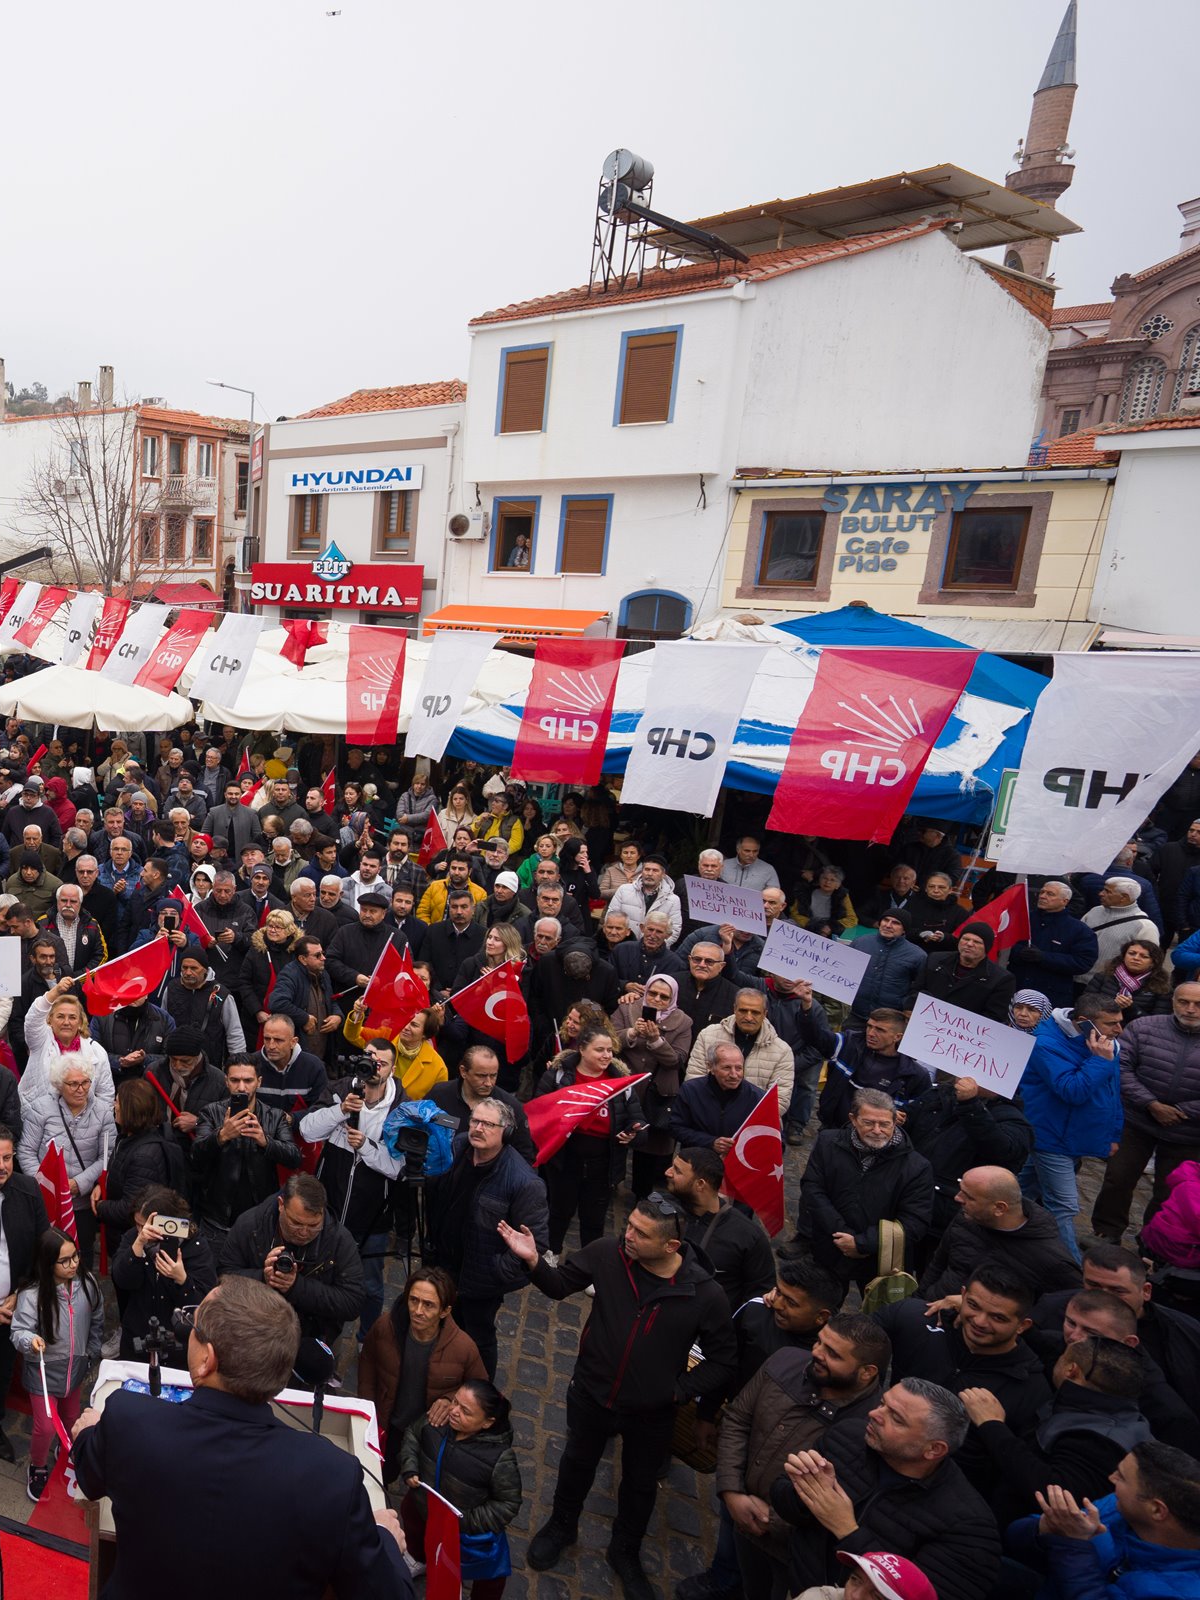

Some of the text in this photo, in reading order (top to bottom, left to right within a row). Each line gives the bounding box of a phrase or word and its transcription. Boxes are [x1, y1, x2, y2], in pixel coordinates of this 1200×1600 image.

[292, 467, 412, 486] HYUNDAI
[821, 481, 982, 513] SARAY
[841, 514, 938, 533] BULUT
[845, 536, 910, 554] Cafe
[311, 556, 351, 574] ELİT
[838, 554, 897, 573] Pide
[156, 651, 182, 669] CHP
[210, 654, 241, 676] CHP
[691, 899, 727, 914] MESUT
[776, 924, 834, 951] AYVALIK
[920, 1001, 993, 1038] AYVALIK
